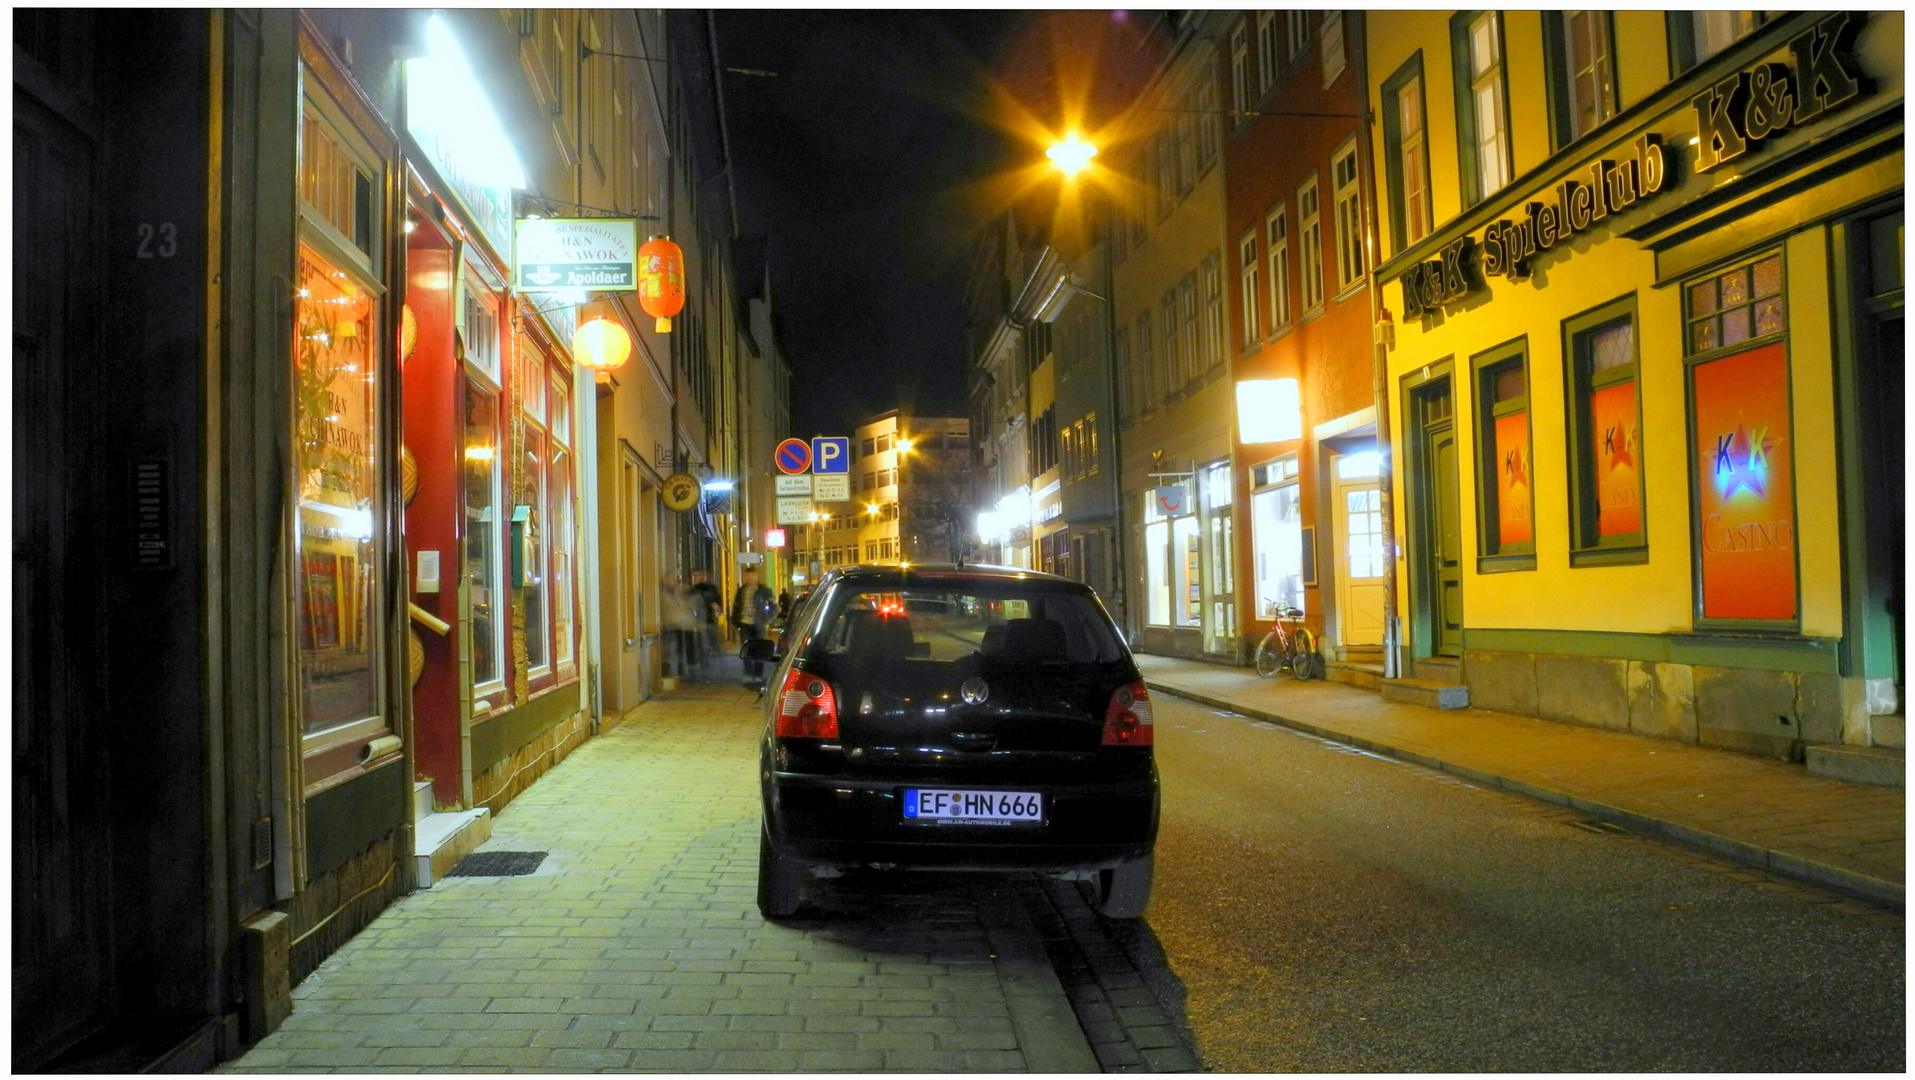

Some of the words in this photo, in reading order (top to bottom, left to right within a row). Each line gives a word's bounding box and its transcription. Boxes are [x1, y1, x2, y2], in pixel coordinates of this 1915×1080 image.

[1693, 12, 1859, 173] K&K
[137, 222, 177, 258] 23
[1401, 237, 1468, 324] K&K
[1482, 132, 1664, 281] Spielclub
[562, 236, 593, 247] H&N
[566, 271, 627, 287] Apoldaer
[327, 391, 347, 416] H&N
[309, 414, 363, 456] CHINAWOK
[821, 442, 840, 470] P
[908, 805, 915, 813] D
[919, 792, 949, 814] EF
[964, 793, 994, 816] HN
[998, 794, 1039, 817] 666
